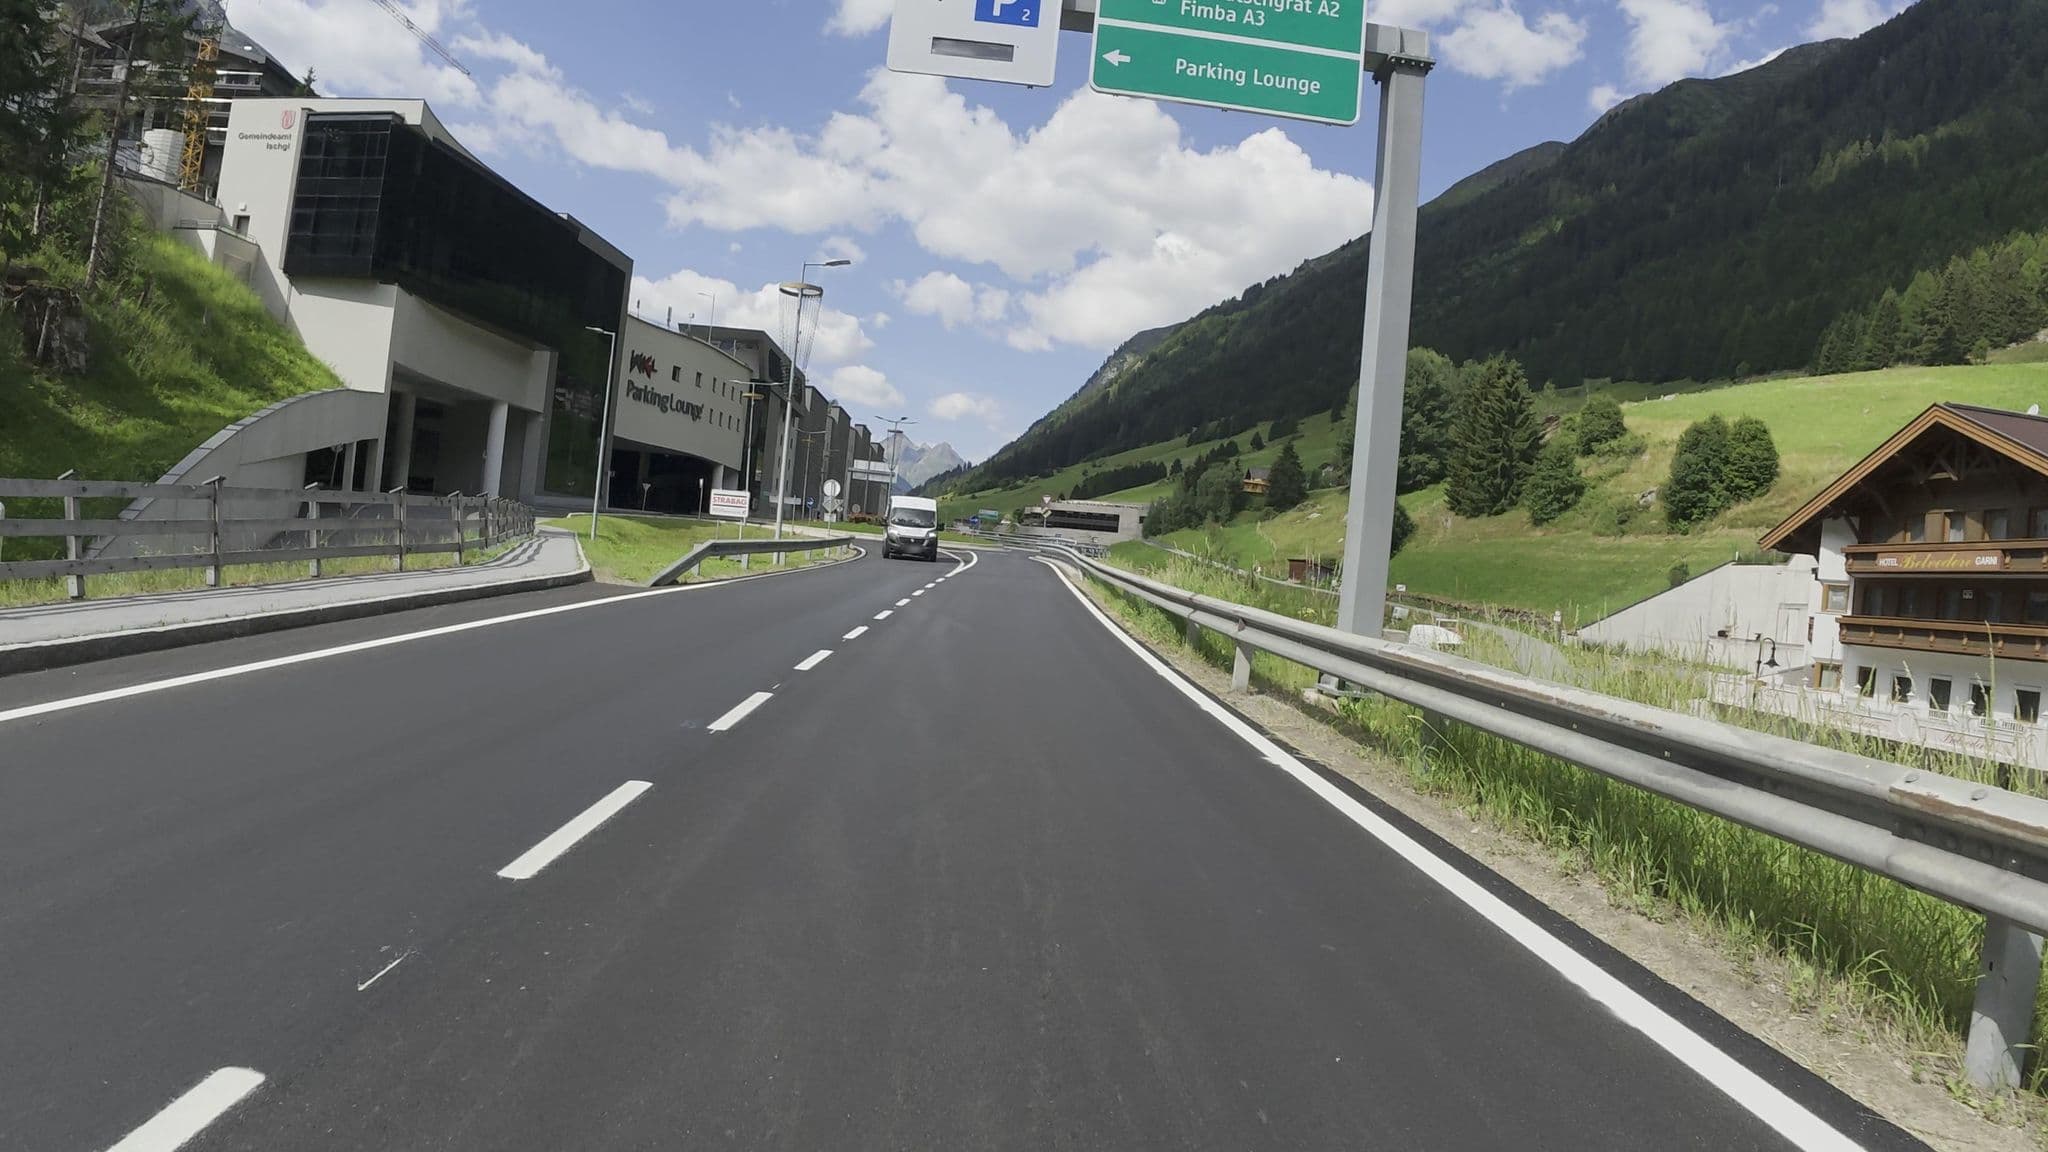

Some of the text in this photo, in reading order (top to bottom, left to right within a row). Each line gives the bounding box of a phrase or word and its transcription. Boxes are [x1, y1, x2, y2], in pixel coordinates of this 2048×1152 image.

[1181, 0, 1266, 26] Fimba A3
[1317, 0, 1340, 18] A2
[1175, 58, 1321, 96] Parking Lounge
[238, 132, 292, 141] Gemeindeamt
[266, 142, 290, 152] Ischgl
[626, 379, 704, 422] Parking Lounge
[1879, 557, 1899, 567] HOTEL
[1974, 555, 1998, 566] GARNI
